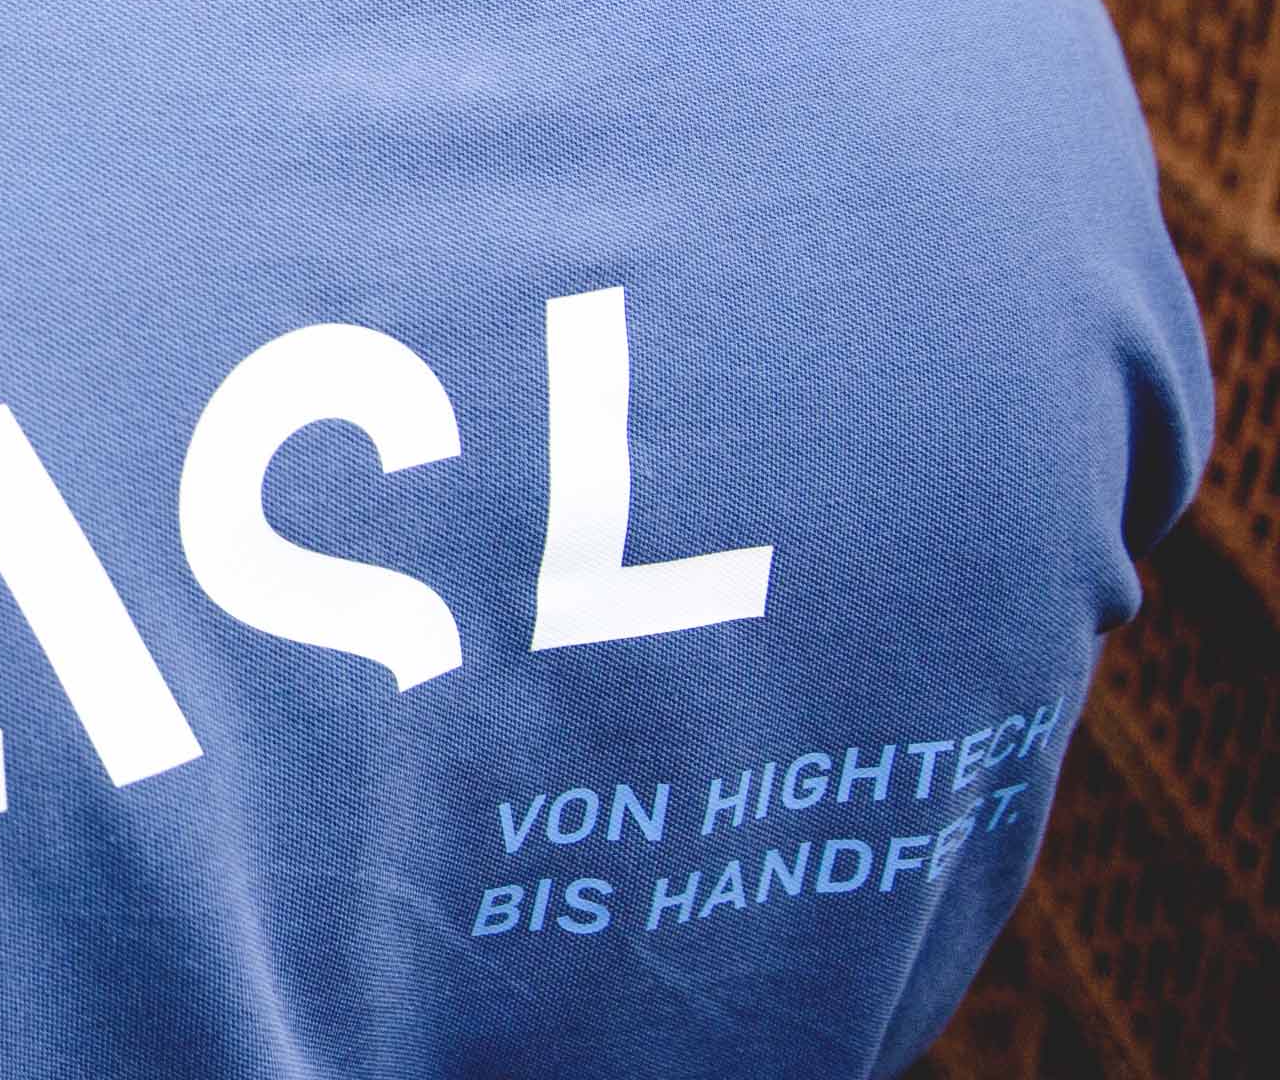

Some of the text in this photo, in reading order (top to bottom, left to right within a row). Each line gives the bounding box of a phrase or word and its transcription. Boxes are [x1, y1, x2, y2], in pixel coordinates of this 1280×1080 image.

[498, 697, 1065, 854] VON HIGHTECH
[471, 877, 613, 937] BIS
